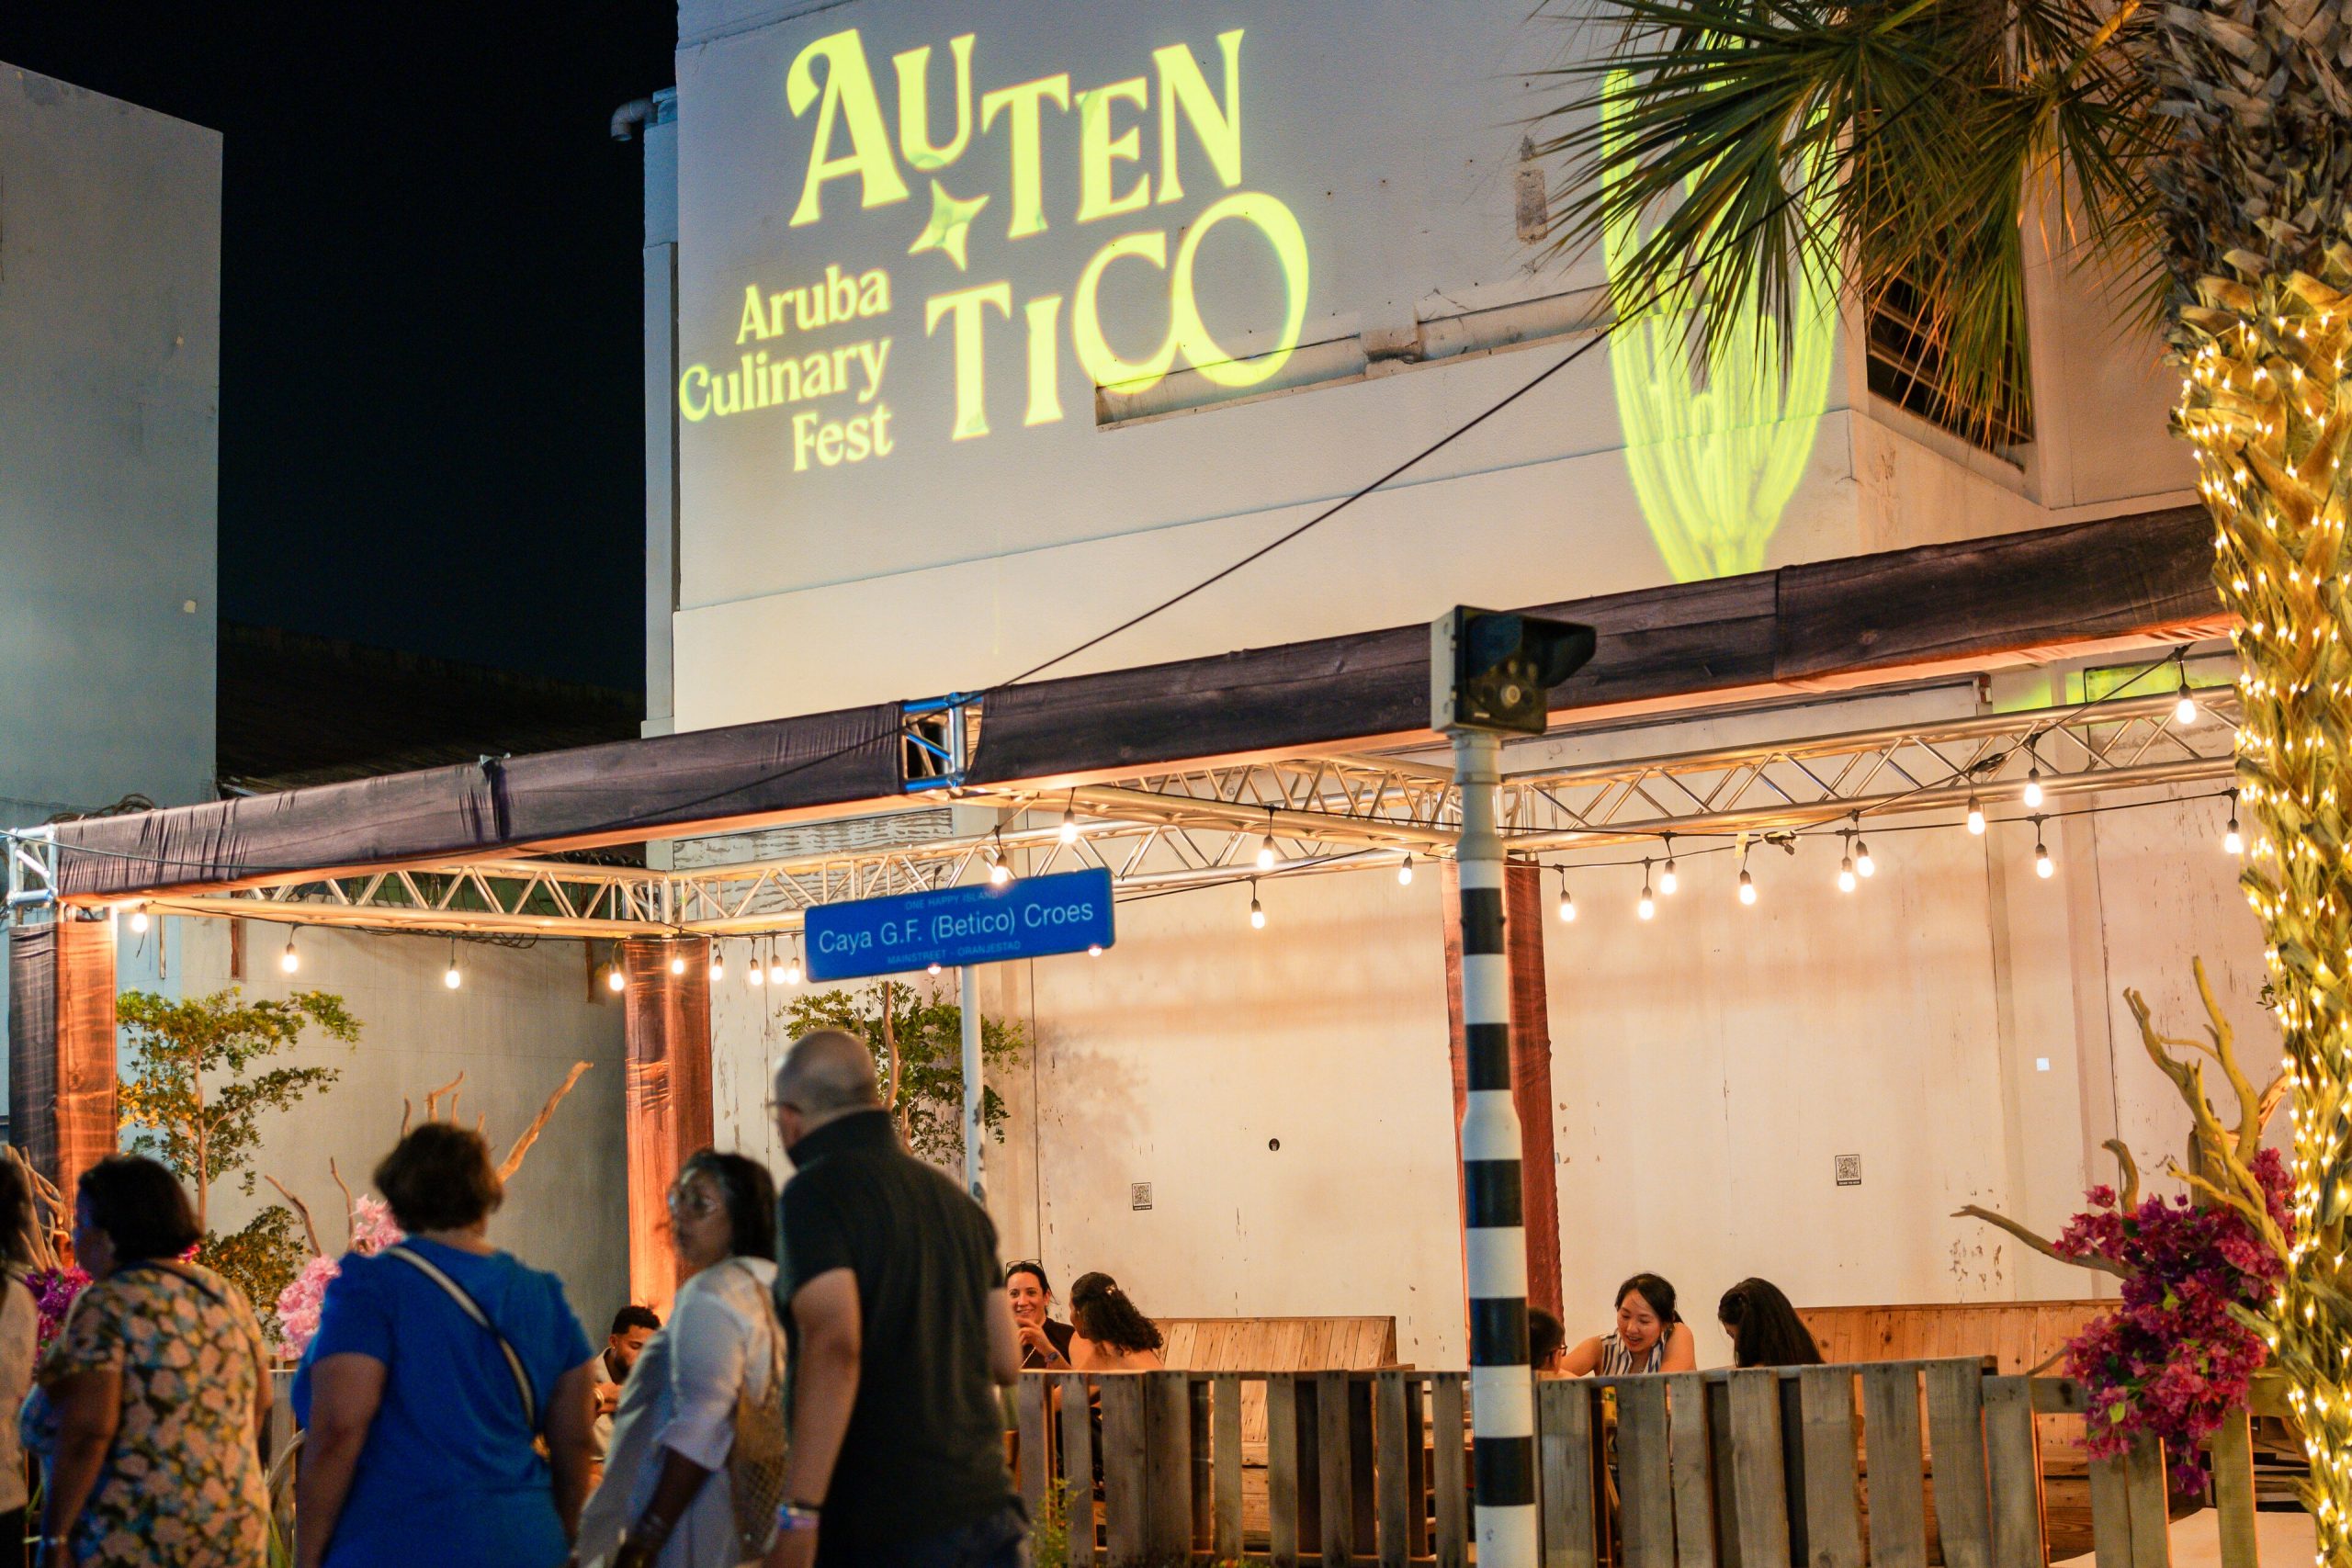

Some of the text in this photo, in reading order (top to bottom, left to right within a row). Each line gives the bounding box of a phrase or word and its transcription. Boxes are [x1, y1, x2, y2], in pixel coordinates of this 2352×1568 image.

[786, 28, 1244, 238] AUTEN
[736, 265, 890, 344] Aruba
[925, 191, 1309, 442] TICO
[679, 338, 890, 422] Culinary
[793, 402, 893, 471] Fest
[819, 901, 1094, 955] Caya G.F. (Betico) Croes
[905, 890, 999, 910] ONE HAPPY ISLAND
[888, 949, 946, 964] MAINSTREET
[957, 940, 1022, 956] ORANJESTAD
